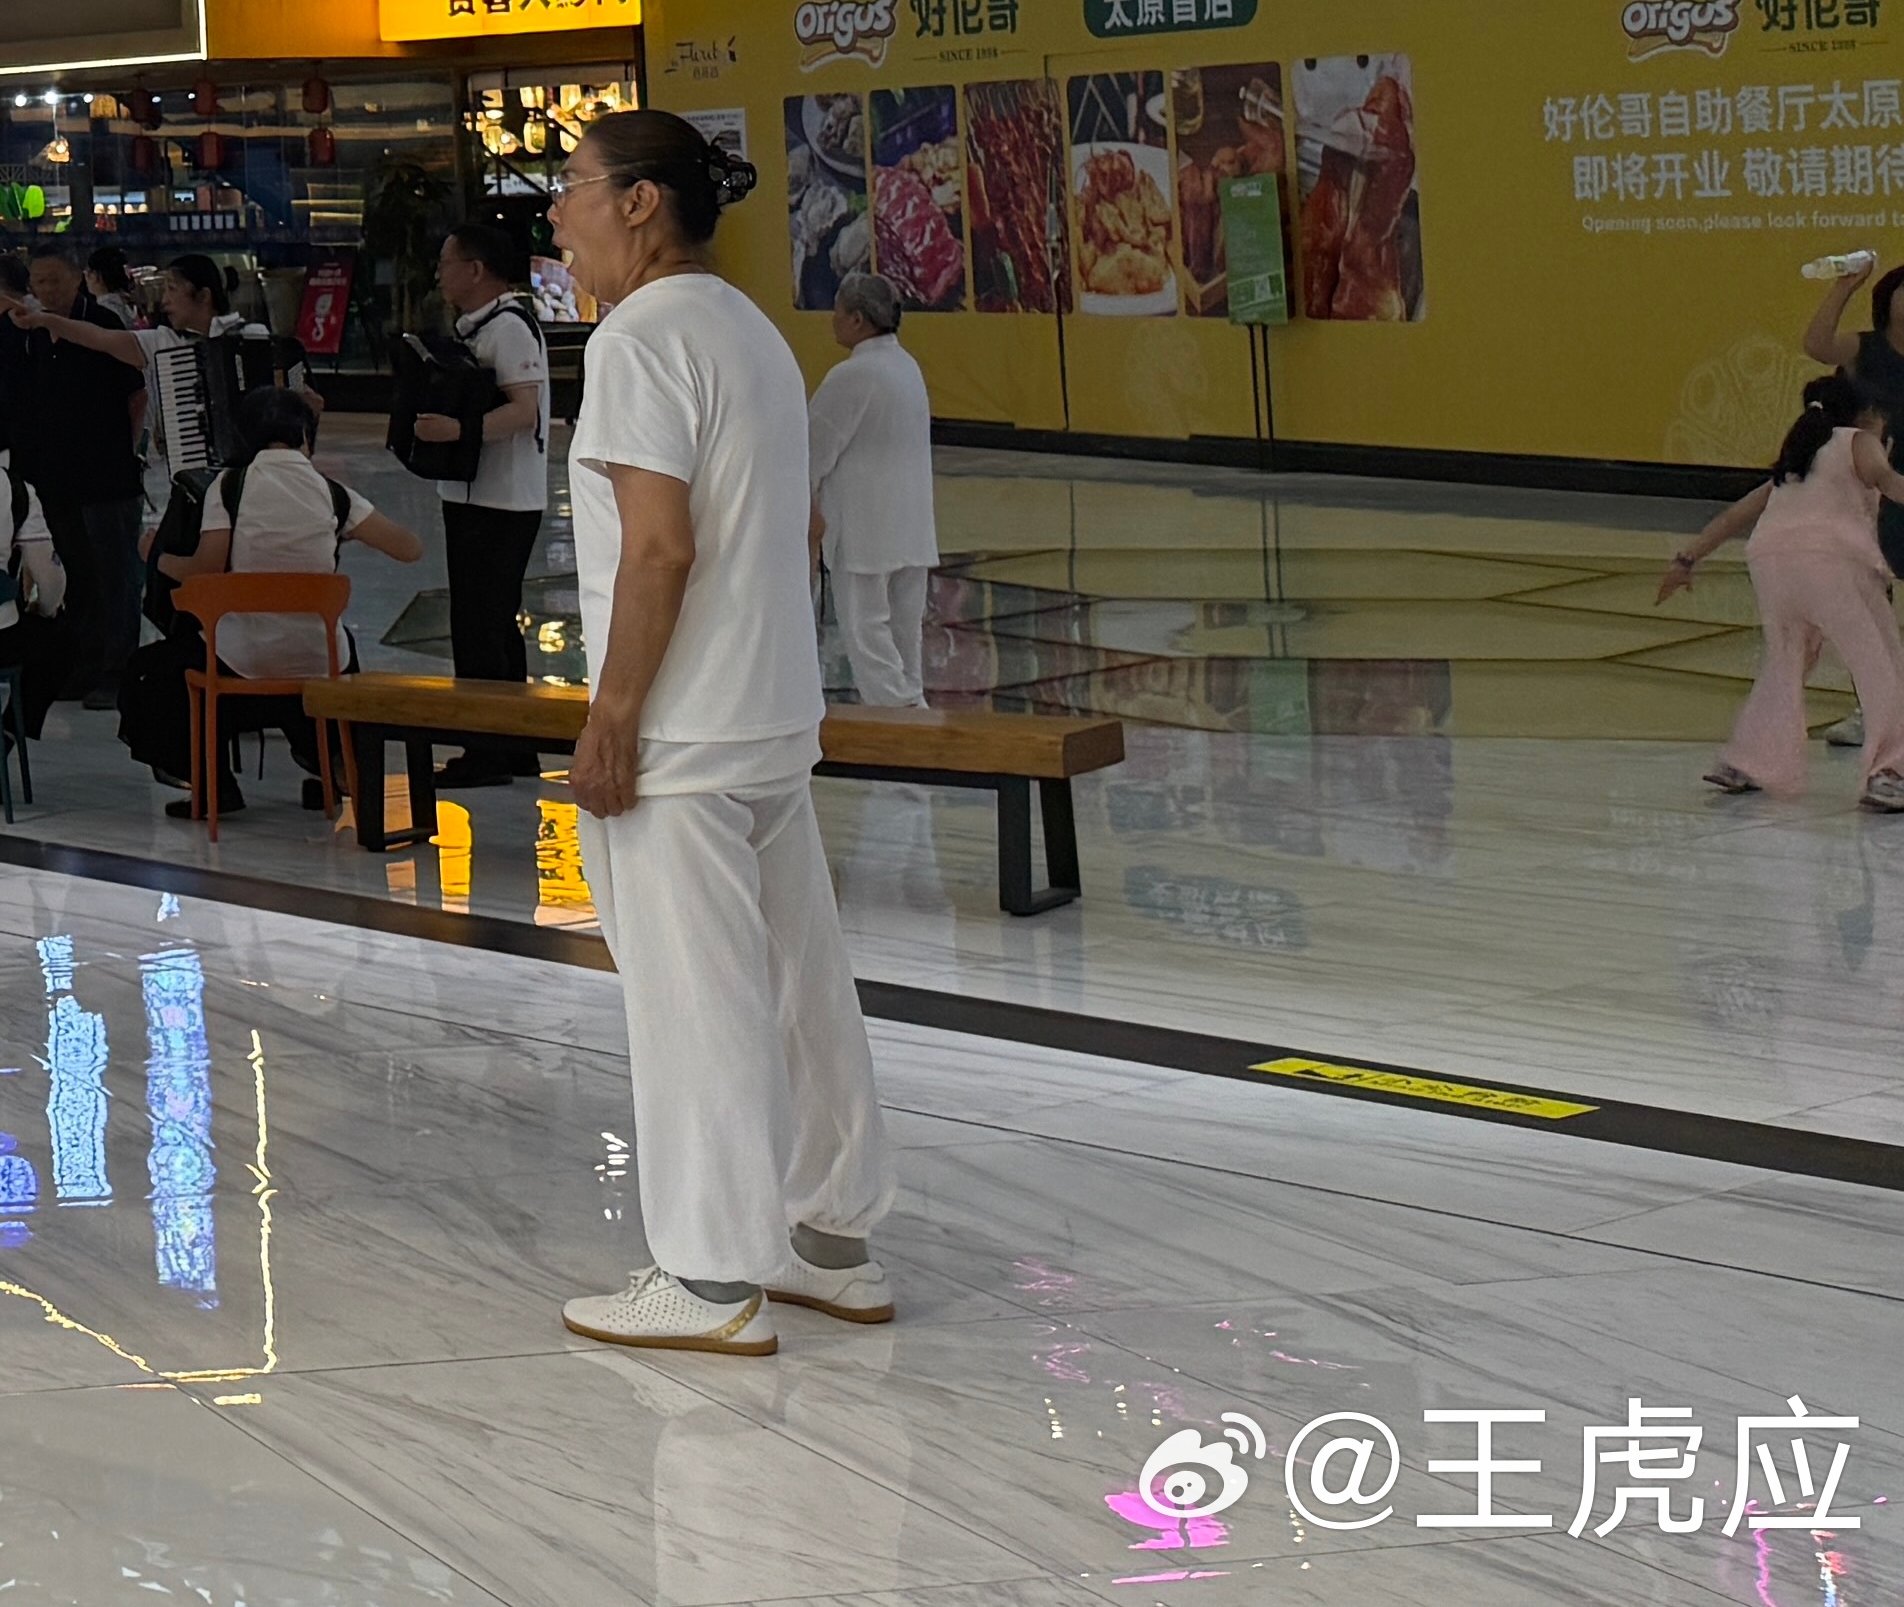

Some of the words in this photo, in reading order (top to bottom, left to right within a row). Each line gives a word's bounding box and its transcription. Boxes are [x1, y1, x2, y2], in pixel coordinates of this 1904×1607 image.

[1543, 78, 1903, 143] 好伦哥自助餐厅太原
[1573, 150, 1733, 202] 即将开业
[1743, 144, 1904, 197] 敬请期待
[1768, 210, 1808, 229] look
[1812, 209, 1887, 229] forward
